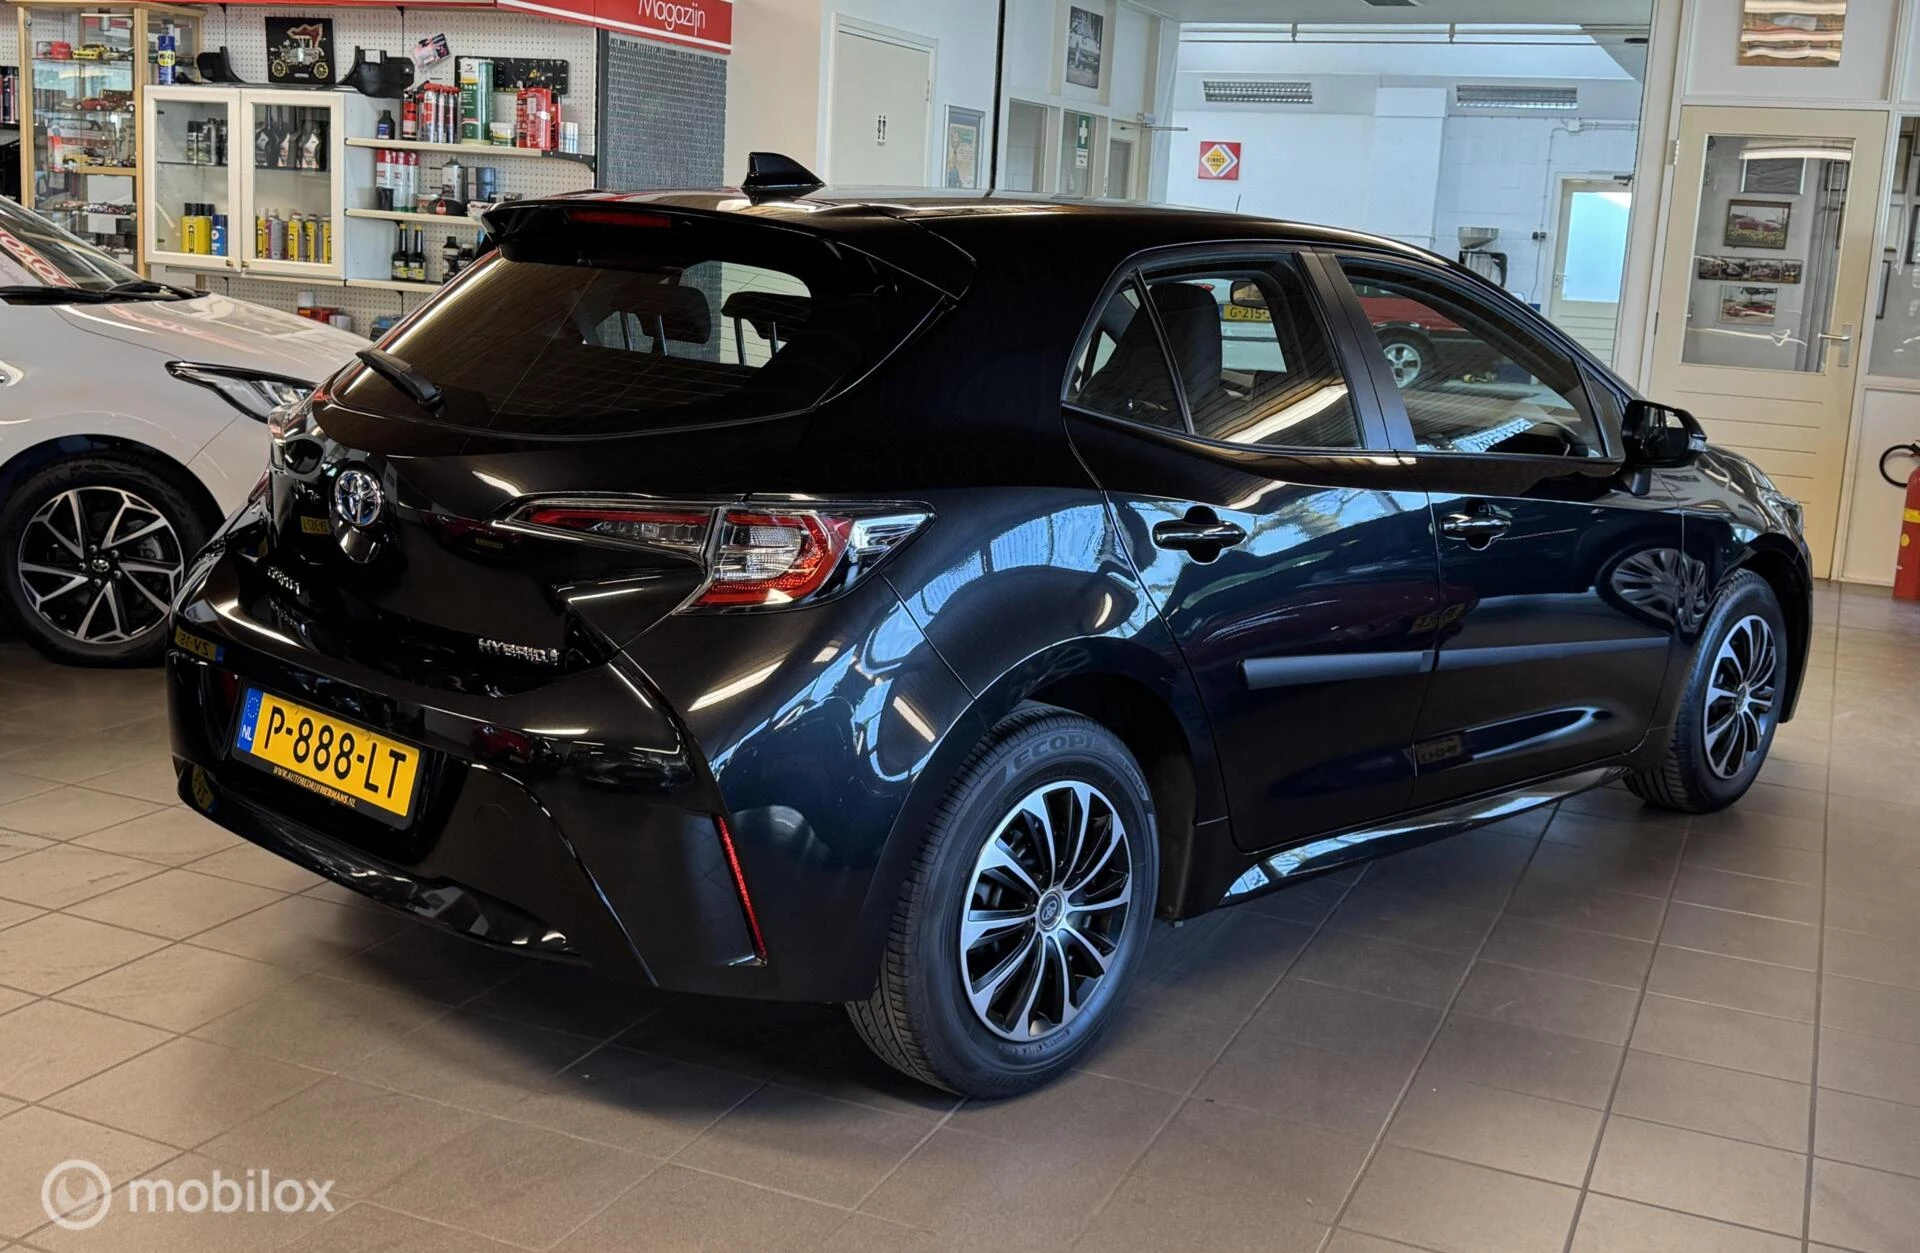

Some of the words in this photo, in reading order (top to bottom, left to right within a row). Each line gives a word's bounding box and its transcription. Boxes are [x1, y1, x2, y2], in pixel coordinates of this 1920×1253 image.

[638, 0, 706, 36] Magazijn
[1230, 306, 1270, 320] G-215-
[478, 638, 549, 662] HYBRID
[241, 724, 253, 742] NL
[264, 705, 408, 799] P-888-LT
